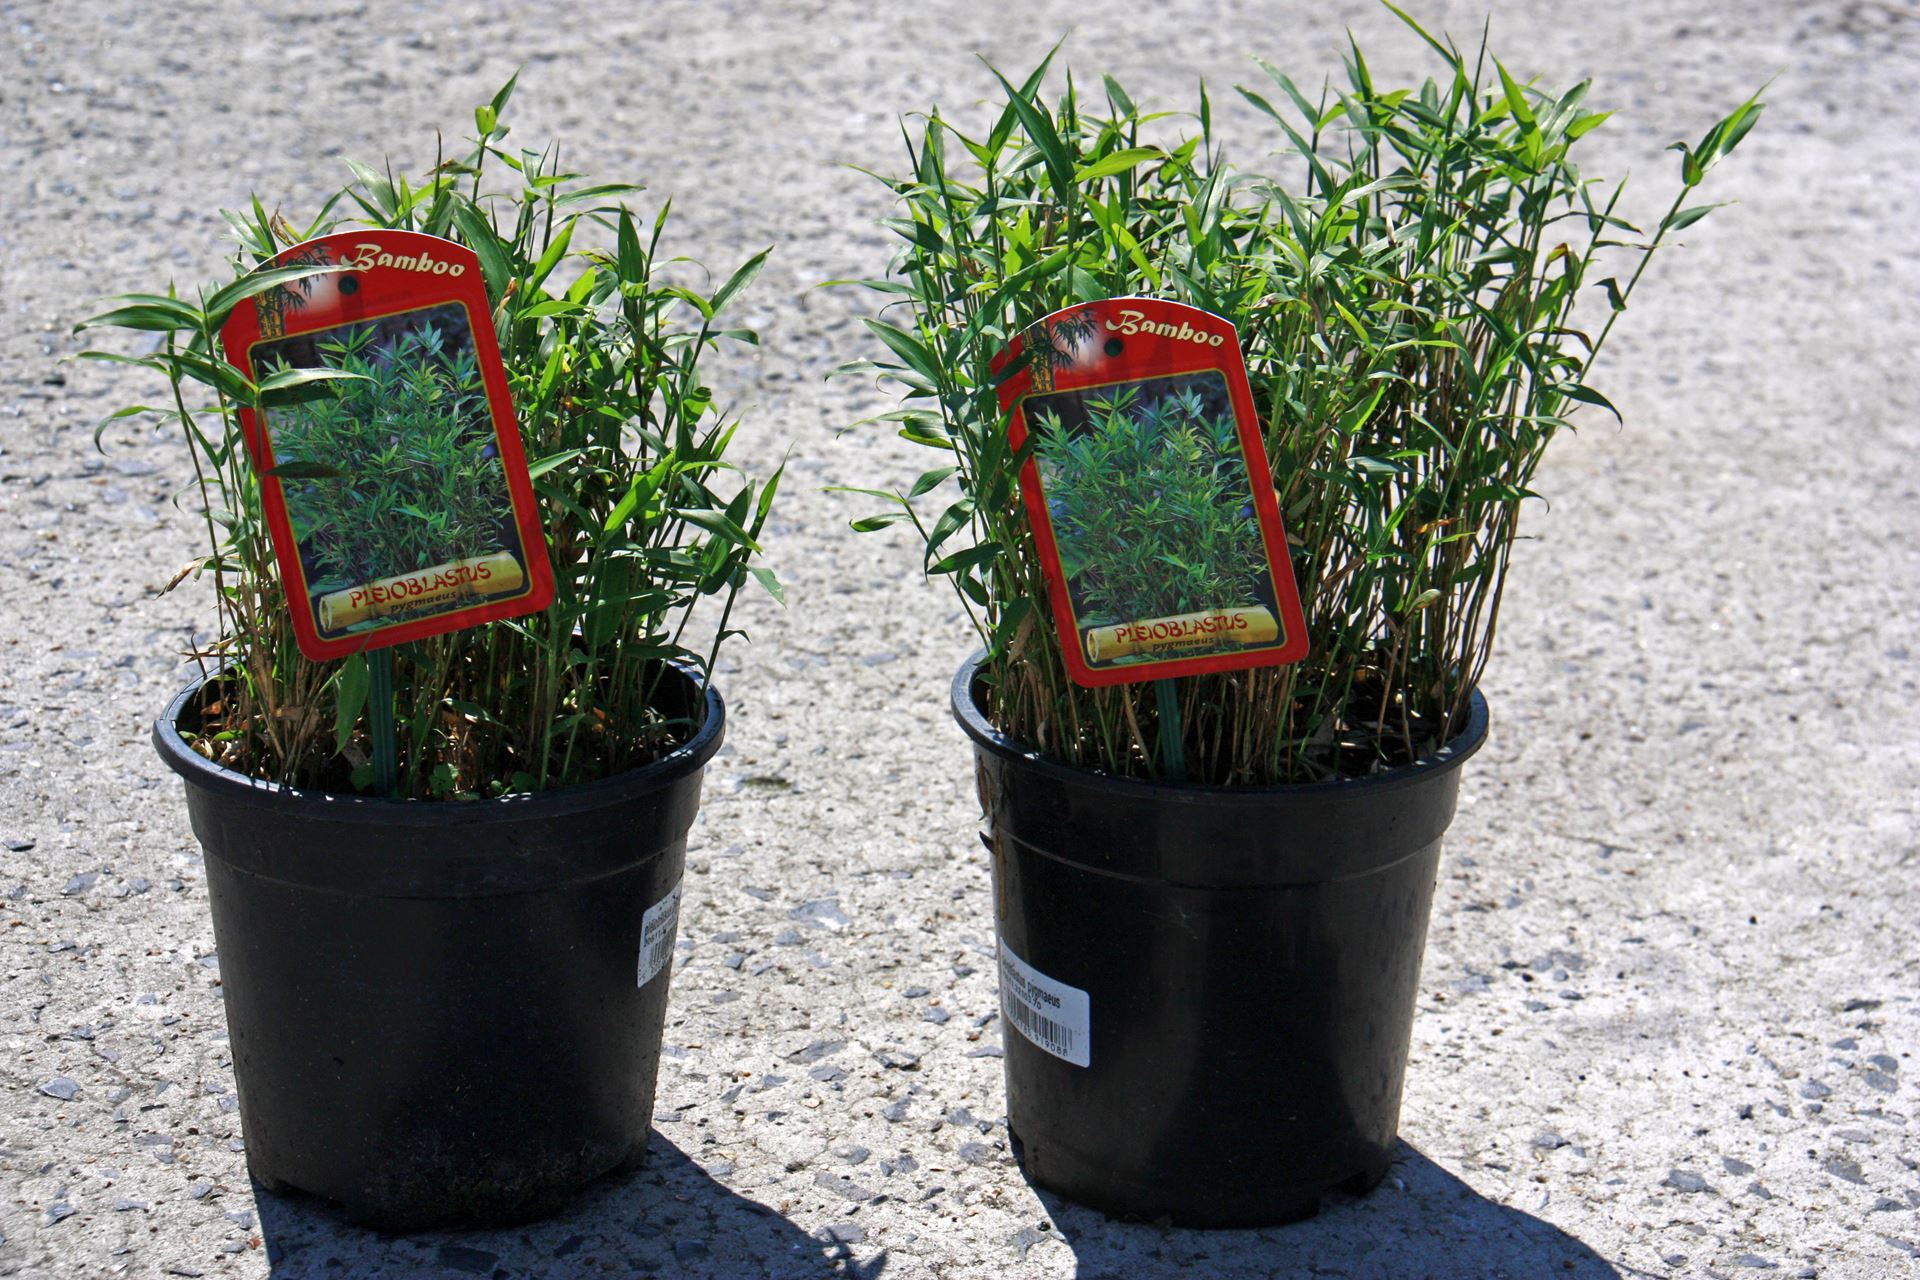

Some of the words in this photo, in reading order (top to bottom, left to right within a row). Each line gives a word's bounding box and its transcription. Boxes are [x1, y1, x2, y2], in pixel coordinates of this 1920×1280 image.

[340, 243, 465, 277] Bamboo
[1105, 310, 1224, 347] Bamboo
[349, 561, 492, 608] PLEIOBLASTUS
[390, 591, 457, 614] pygmaeus
[1114, 612, 1248, 644] PLEIOBLASTUS
[1152, 636, 1216, 651] pygmaeus
